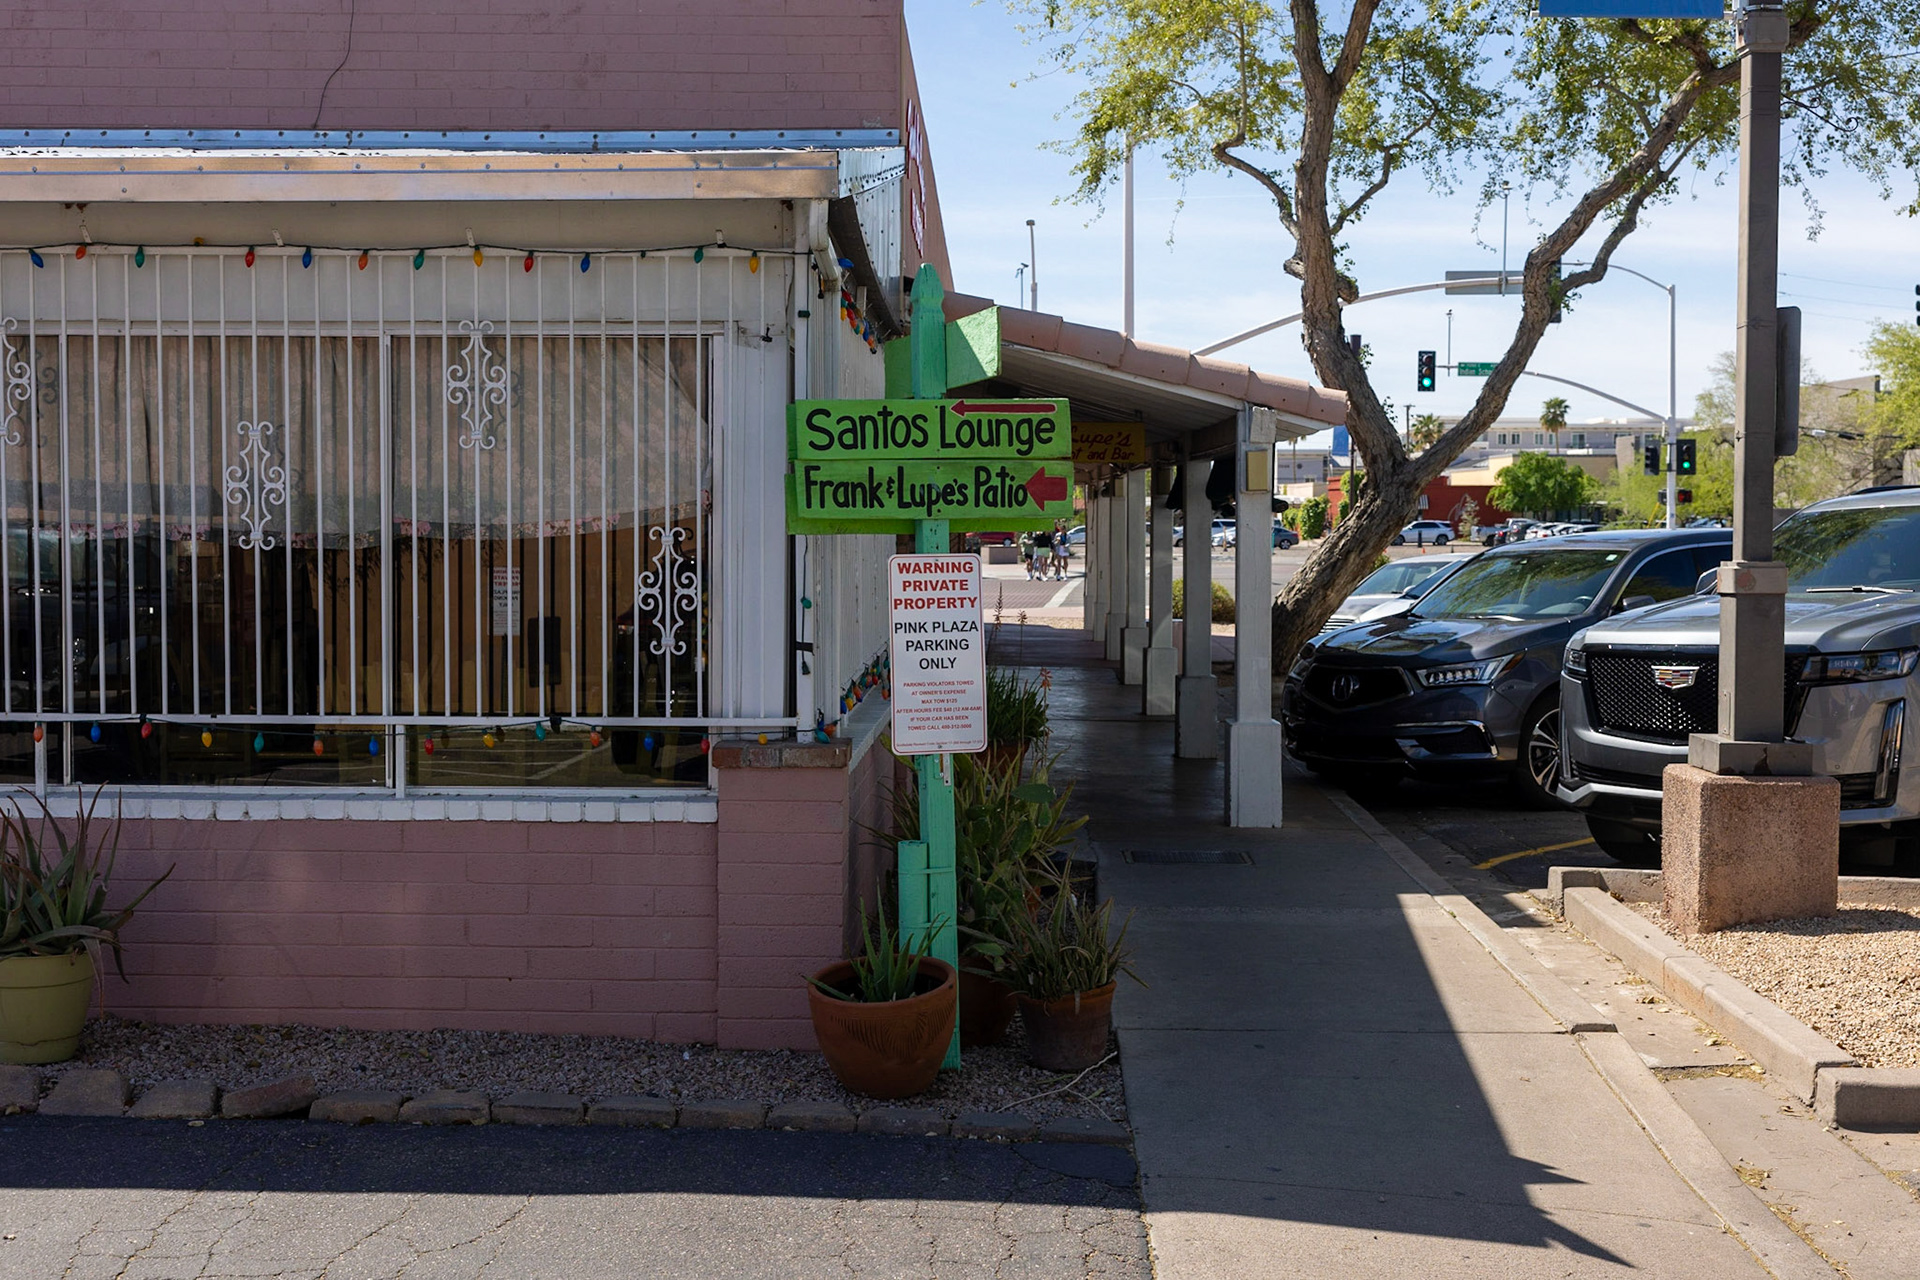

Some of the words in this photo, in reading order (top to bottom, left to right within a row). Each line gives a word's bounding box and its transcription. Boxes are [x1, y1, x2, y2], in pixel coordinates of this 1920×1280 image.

[805, 405, 929, 451] Santos
[940, 405, 1056, 456] Lounge
[1111, 447, 1135, 460] Bar
[804, 465, 885, 509] Frank
[897, 466, 968, 517] Lupe's
[974, 466, 1028, 508] Patio
[898, 562, 974, 574] WARNING
[902, 580, 968, 592] PRIVATE
[894, 596, 978, 610] PROPERTY
[894, 622, 928, 634] PINK
[933, 621, 979, 633] PLAZA
[906, 639, 969, 652] PARKING
[919, 657, 957, 670] ONLY
